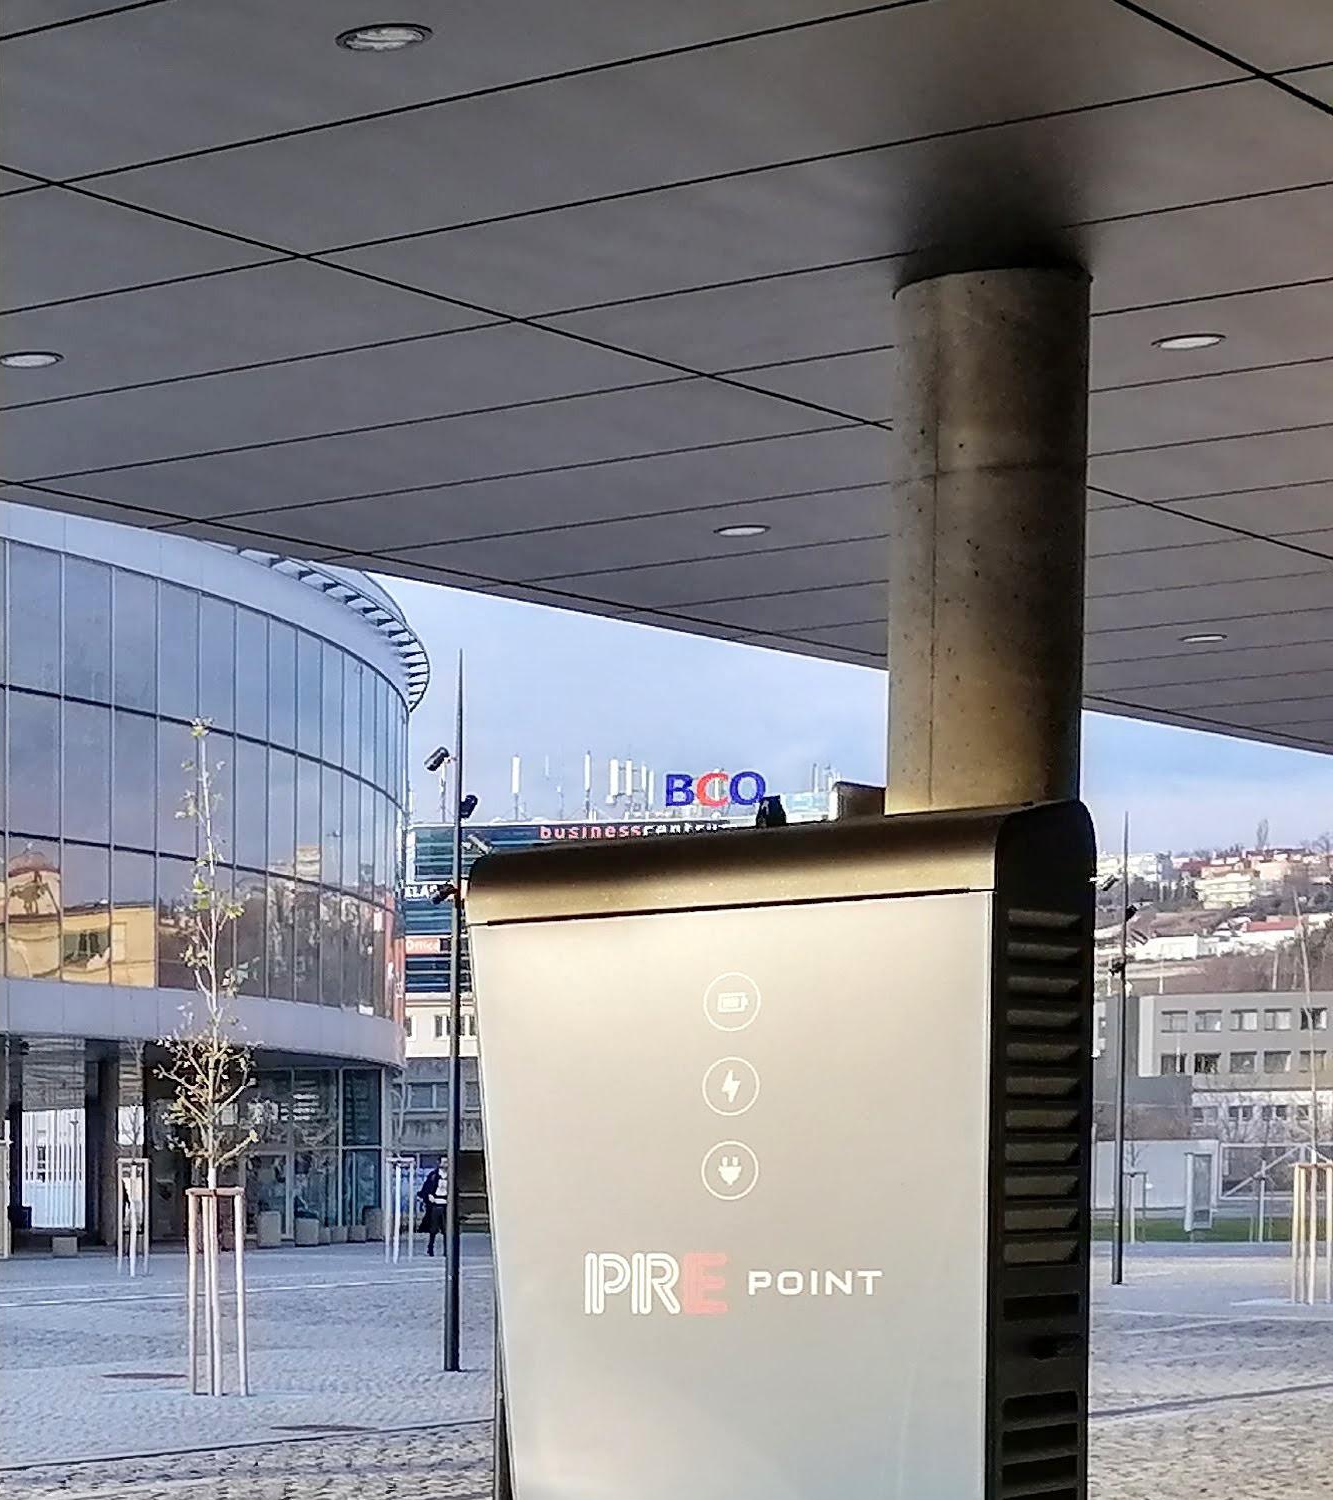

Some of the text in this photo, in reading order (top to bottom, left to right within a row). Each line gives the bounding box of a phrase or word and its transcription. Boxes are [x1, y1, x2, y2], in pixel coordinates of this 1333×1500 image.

[665, 771, 766, 808] BCO
[584, 1252, 883, 1315] PRE POINT
